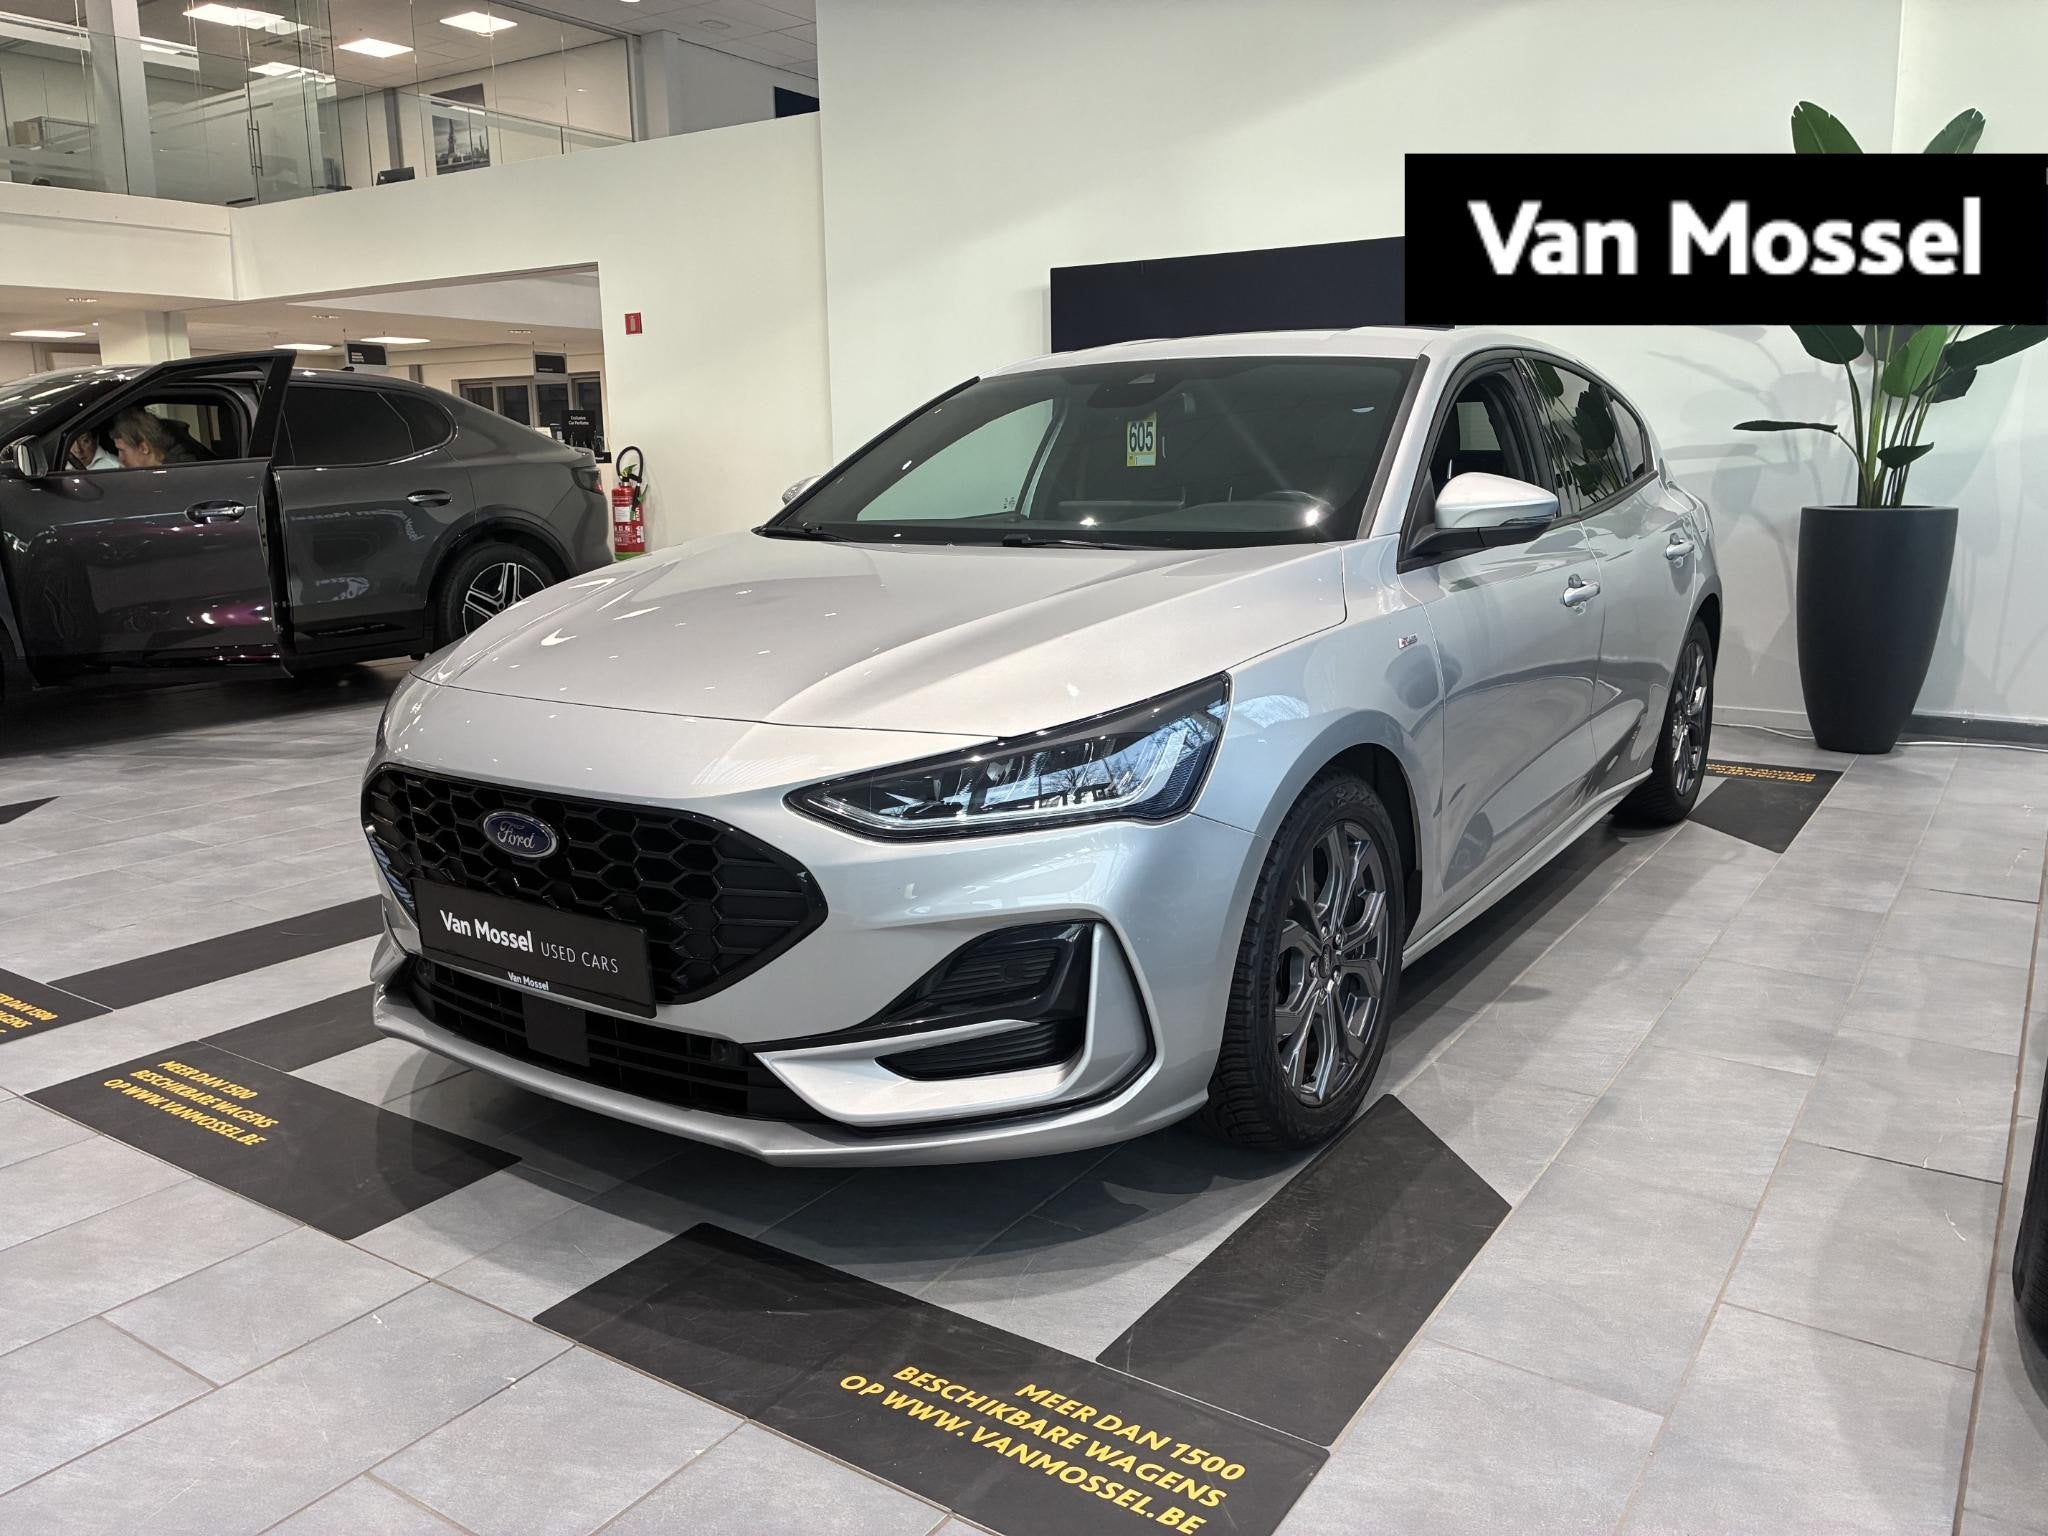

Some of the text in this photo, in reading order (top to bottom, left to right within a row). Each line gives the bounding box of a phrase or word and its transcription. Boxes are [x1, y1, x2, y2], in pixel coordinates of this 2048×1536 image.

[1129, 421, 1154, 453] 605
[497, 820, 537, 849] Ford
[439, 909, 619, 974] Van Mossel USED CARS
[507, 971, 550, 991] Van Mossel
[103, 1079, 131, 1090] OP
[156, 1060, 258, 1100] MEER DAN 1500
[129, 1069, 279, 1128] BESCHIKBARE WAGENS
[839, 1374, 885, 1396] OP
[893, 1366, 1228, 1508] BESCHIKBARE WAGENS
[1015, 1383, 1246, 1481] MEER DAN 1500
